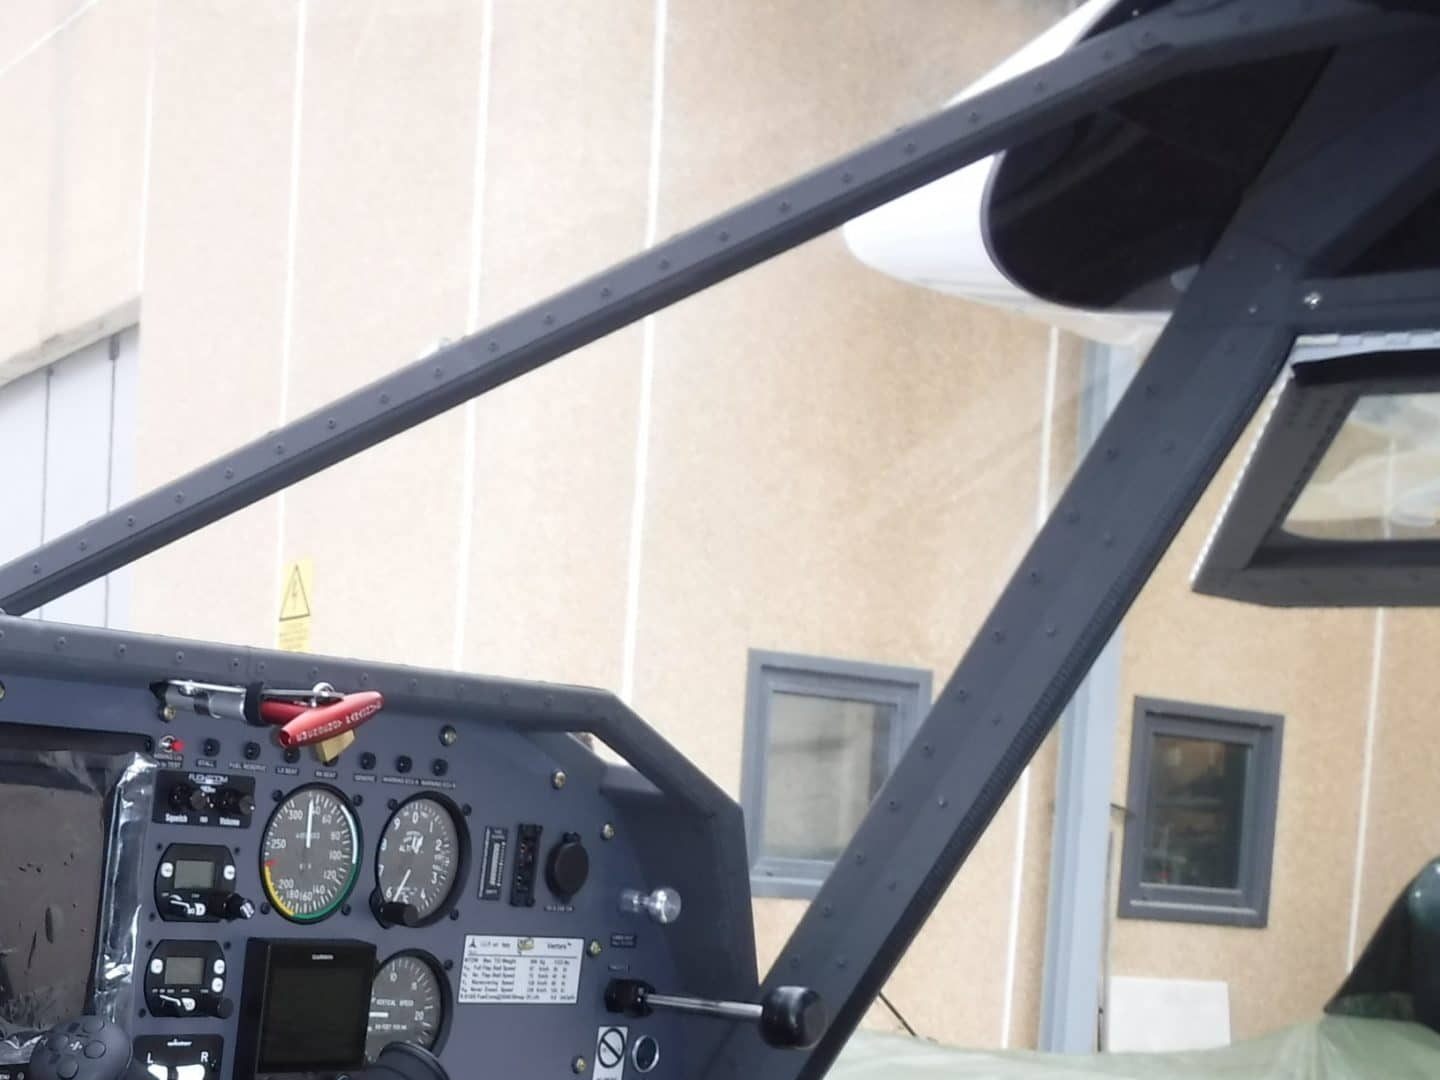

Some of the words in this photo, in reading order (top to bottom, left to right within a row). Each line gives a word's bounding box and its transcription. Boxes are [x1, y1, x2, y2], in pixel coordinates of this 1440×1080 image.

[287, 809, 304, 821] 300
[321, 815, 332, 825] 60
[412, 811, 419, 824] 0
[393, 817, 401, 831] 9
[270, 838, 287, 849] 250
[435, 838, 442, 851] 2
[329, 850, 342, 861] 100
[323, 870, 337, 881] 120
[431, 871, 438, 885] 3
[278, 878, 295, 890] 200
[312, 884, 326, 895] 140
[286, 889, 300, 900] 180
[300, 890, 313, 901] 160
[385, 886, 393, 899] 6
[420, 888, 426, 900] 4
[414, 1010, 425, 1021] 20
[146, 1051, 154, 1065] L
[200, 1051, 209, 1063] R
